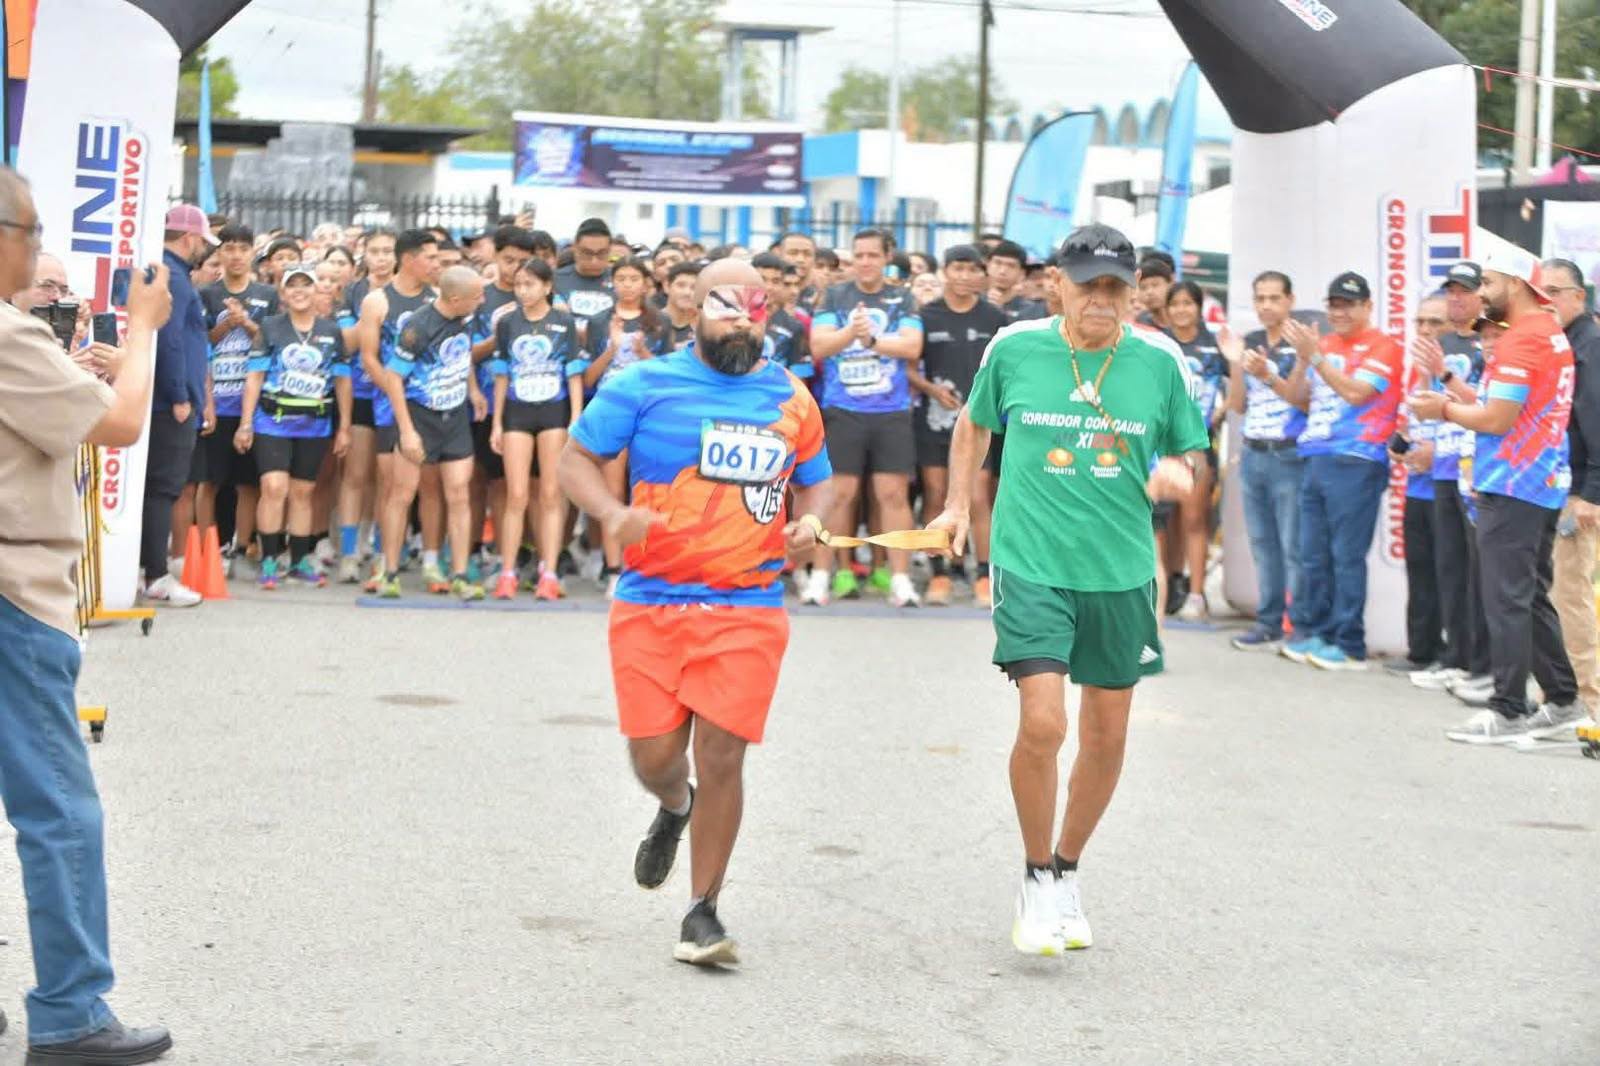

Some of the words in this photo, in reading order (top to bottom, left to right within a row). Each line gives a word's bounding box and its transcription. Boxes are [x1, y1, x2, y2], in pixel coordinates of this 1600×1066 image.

[117, 138, 142, 269] EPORTIVO
[1021, 411, 1082, 429] CORREDOR
[1084, 415, 1110, 431] CON
[707, 441, 781, 472] 0617
